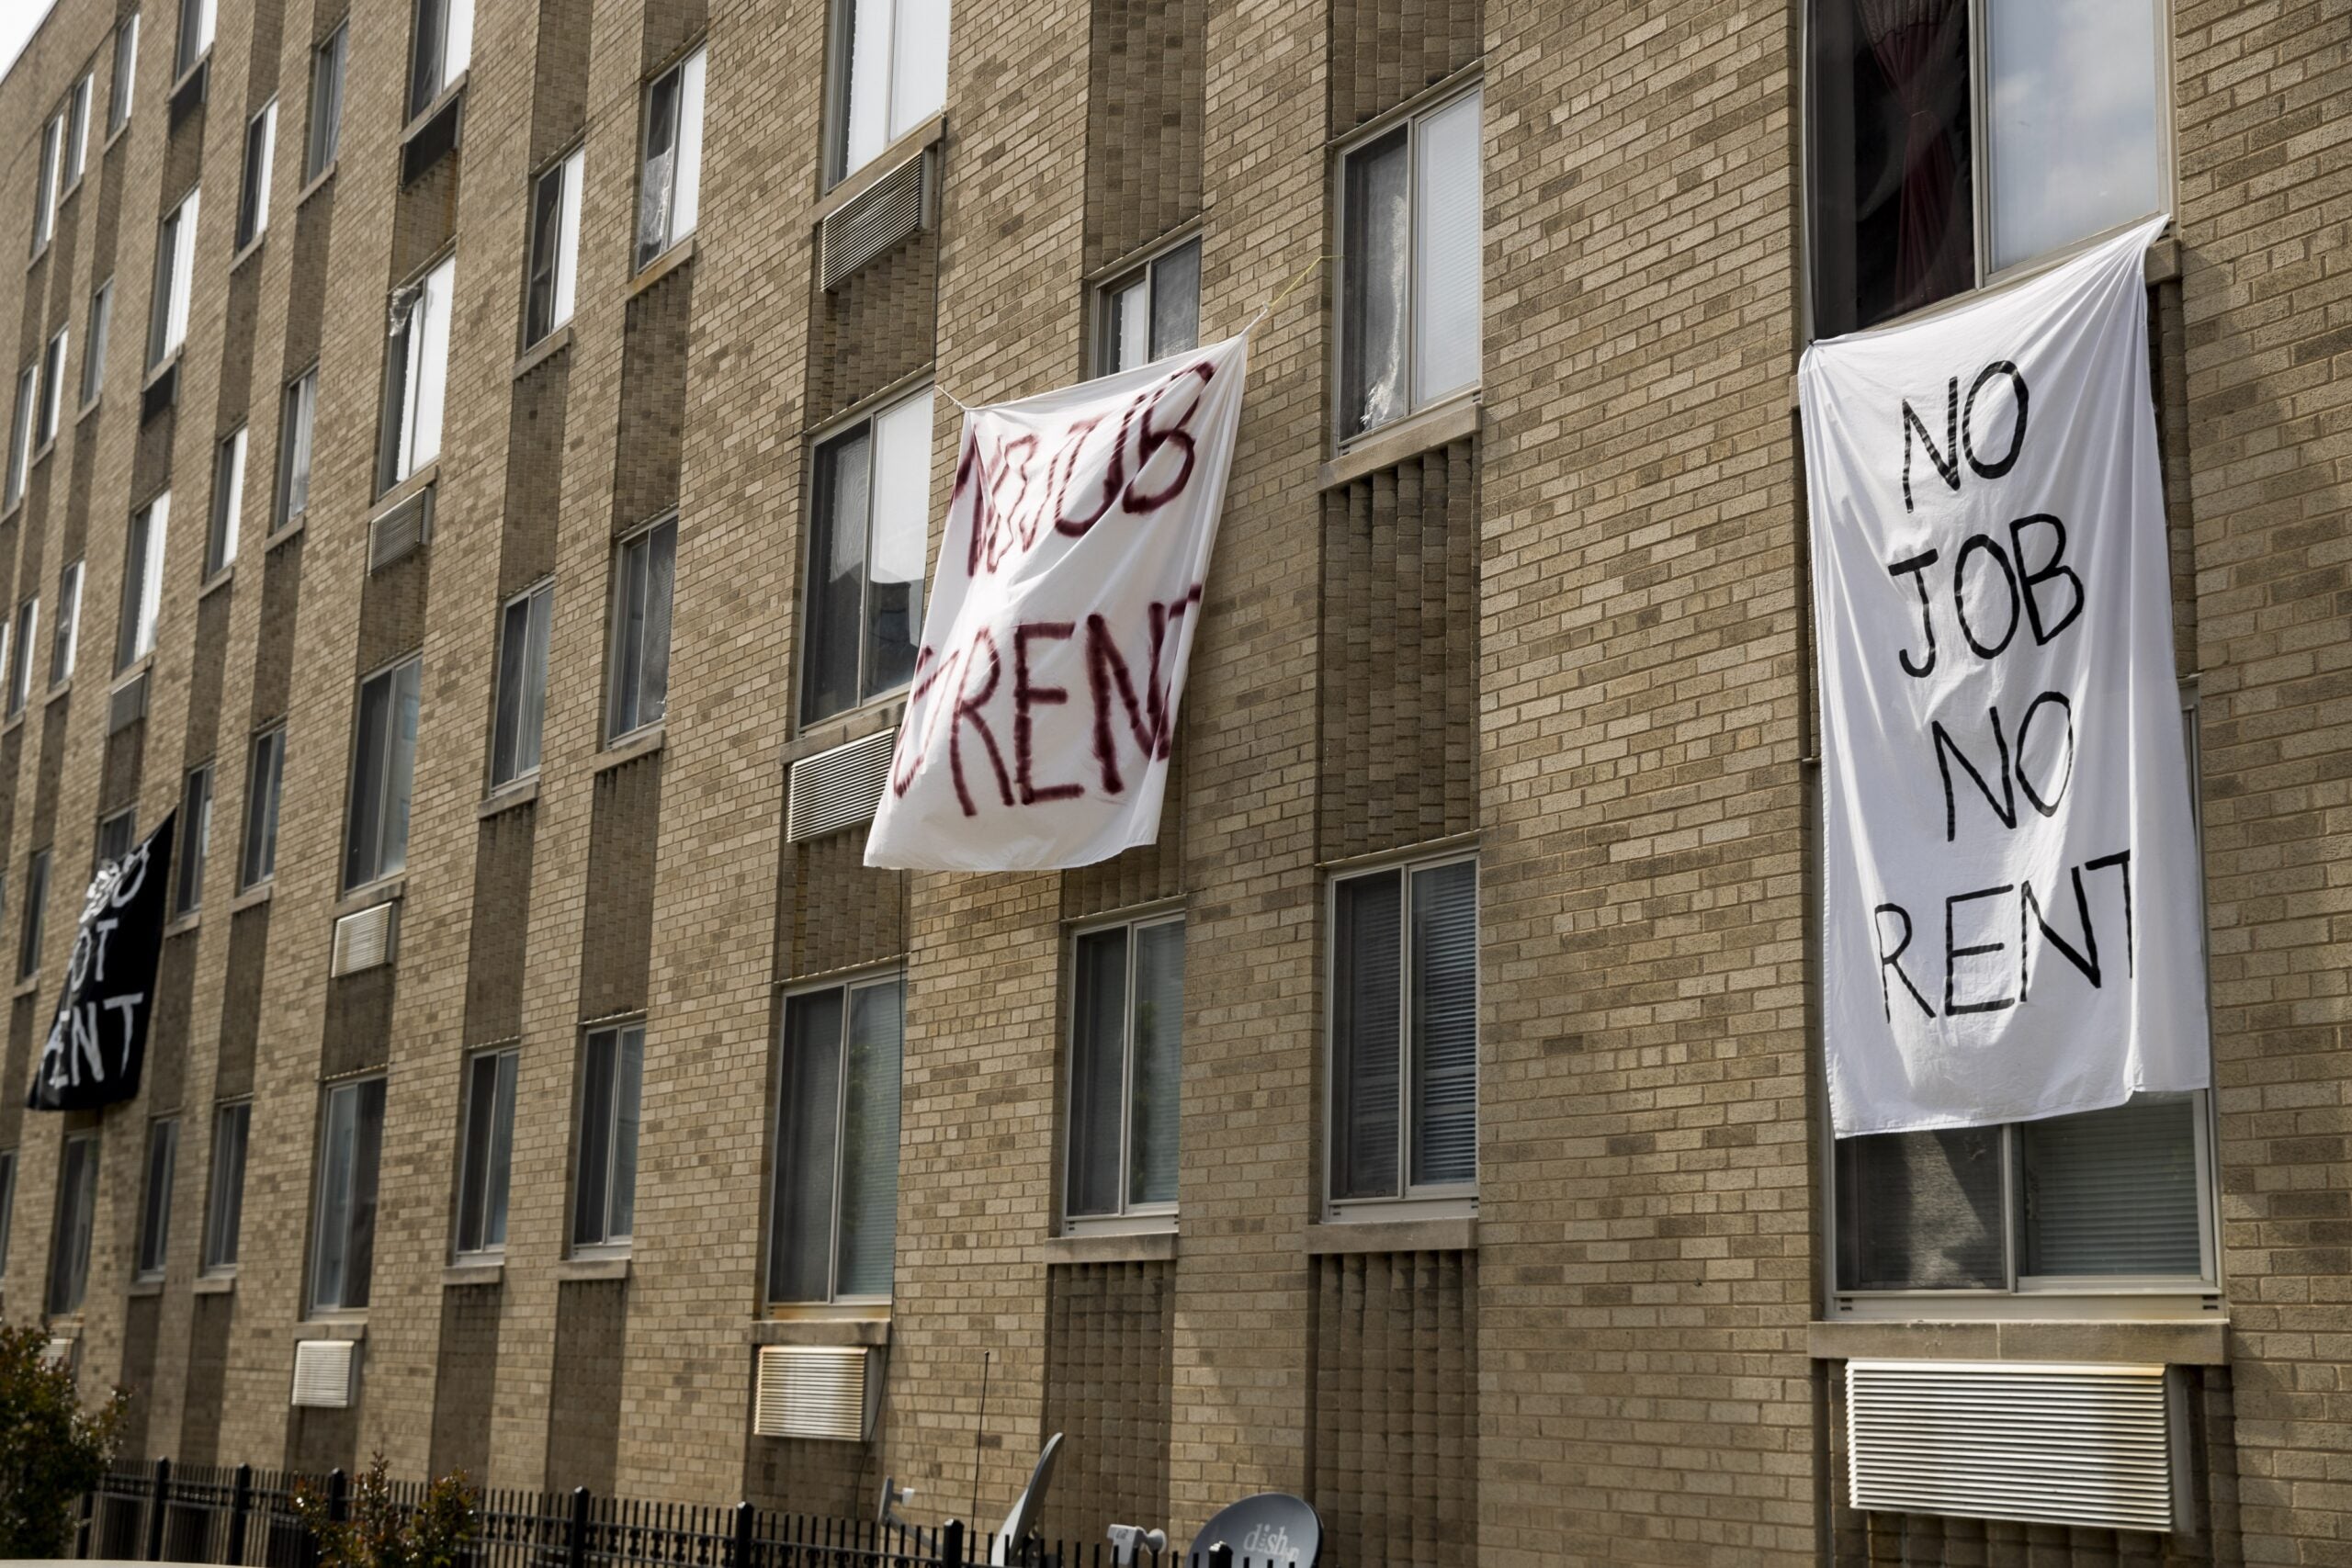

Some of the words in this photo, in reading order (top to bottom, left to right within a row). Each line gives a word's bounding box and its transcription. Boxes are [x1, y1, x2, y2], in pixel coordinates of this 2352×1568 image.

[1902, 360, 2030, 513] NO
[1888, 513, 2084, 679] JOB
[1931, 691, 2075, 843] NO
[1874, 849, 2134, 1025] RENT
[1243, 1522, 1289, 1555] dish
